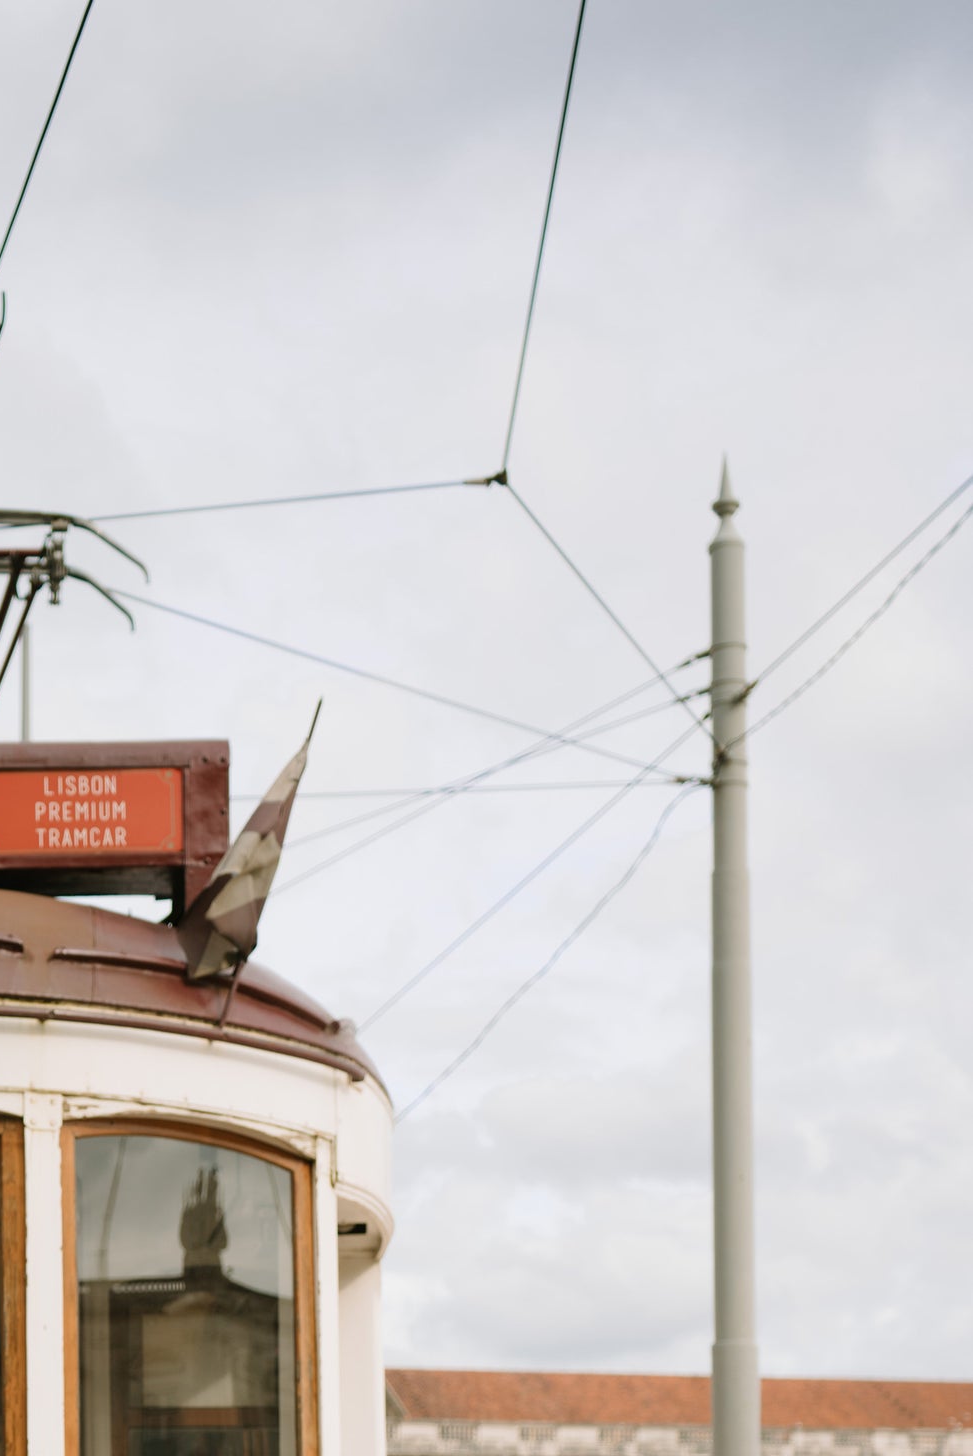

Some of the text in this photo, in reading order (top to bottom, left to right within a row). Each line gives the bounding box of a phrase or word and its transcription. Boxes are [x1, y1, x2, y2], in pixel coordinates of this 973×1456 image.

[43, 775, 117, 796] LISBON
[35, 800, 127, 822] PREMIUM
[35, 826, 127, 848] TRAMCAR
